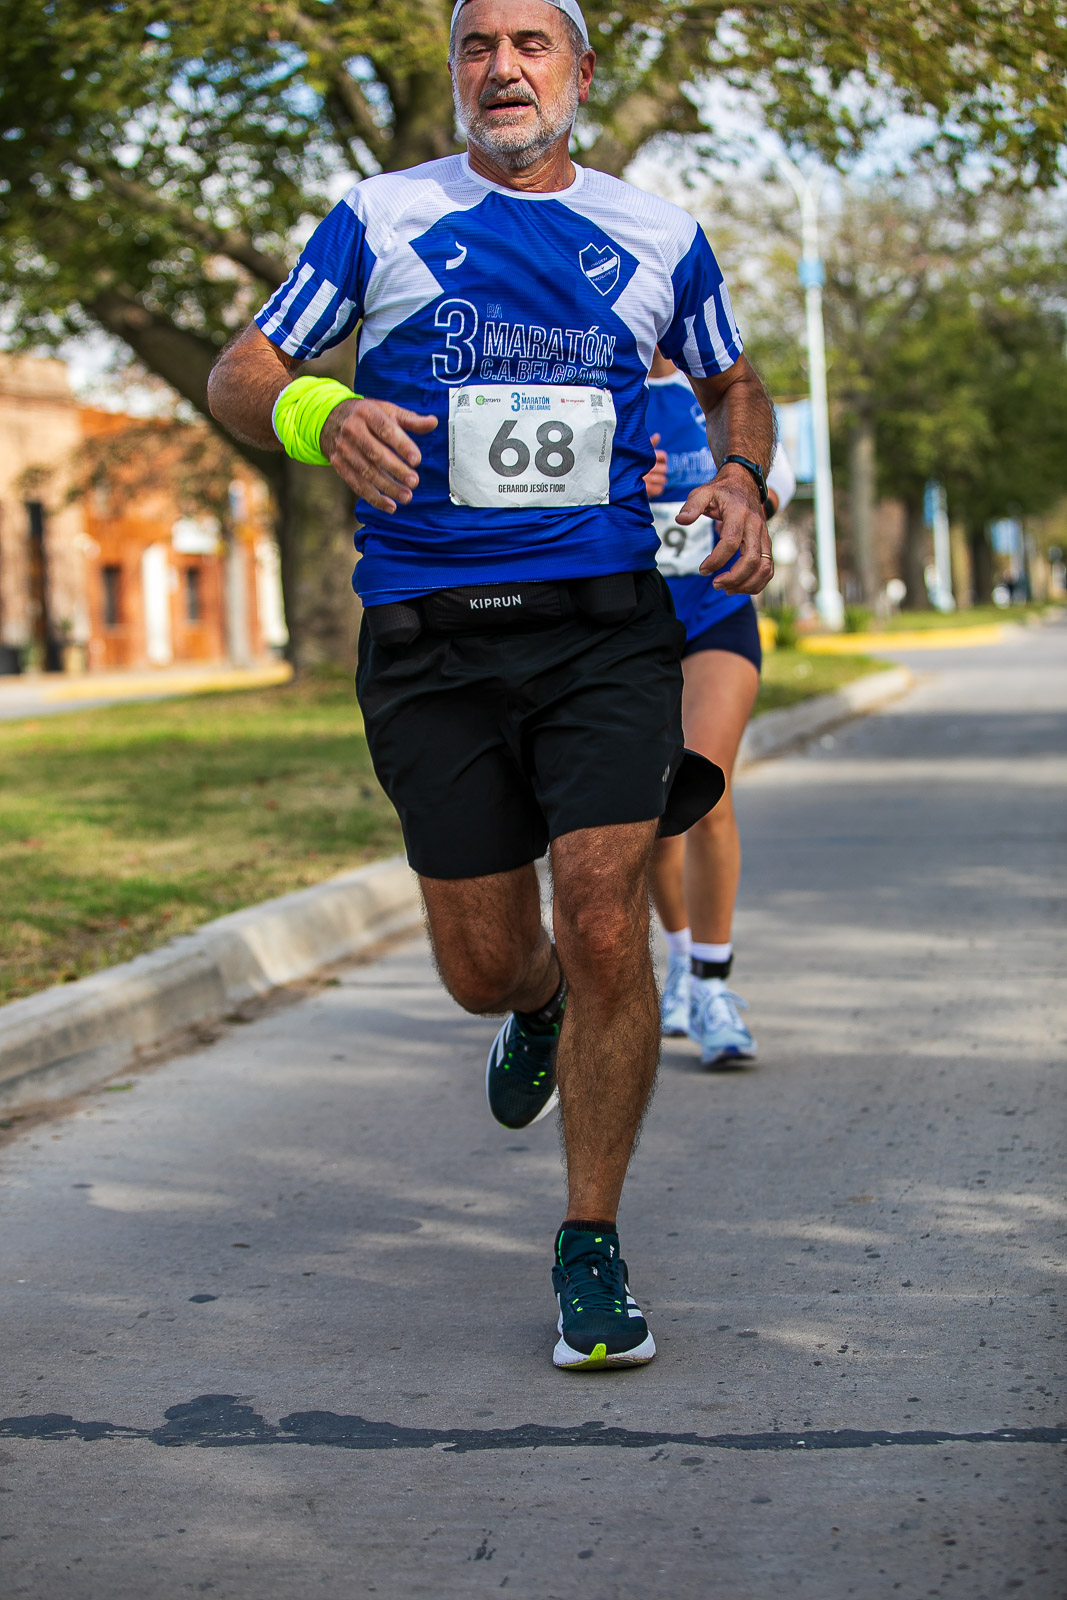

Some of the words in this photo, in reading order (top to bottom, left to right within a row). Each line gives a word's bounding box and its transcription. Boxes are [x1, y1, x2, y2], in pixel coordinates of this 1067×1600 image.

[432, 298, 479, 384] 3
[486, 303, 502, 319] RA
[483, 321, 616, 367] MARATÓN
[510, 392, 520, 412] 3
[521, 396, 550, 405] MARATÓN
[488, 419, 576, 478] 68
[498, 484, 529, 493] GERARDO
[529, 482, 549, 493] JESÚS
[549, 483, 566, 493] FIORI
[469, 594, 522, 609] KIPRUN
